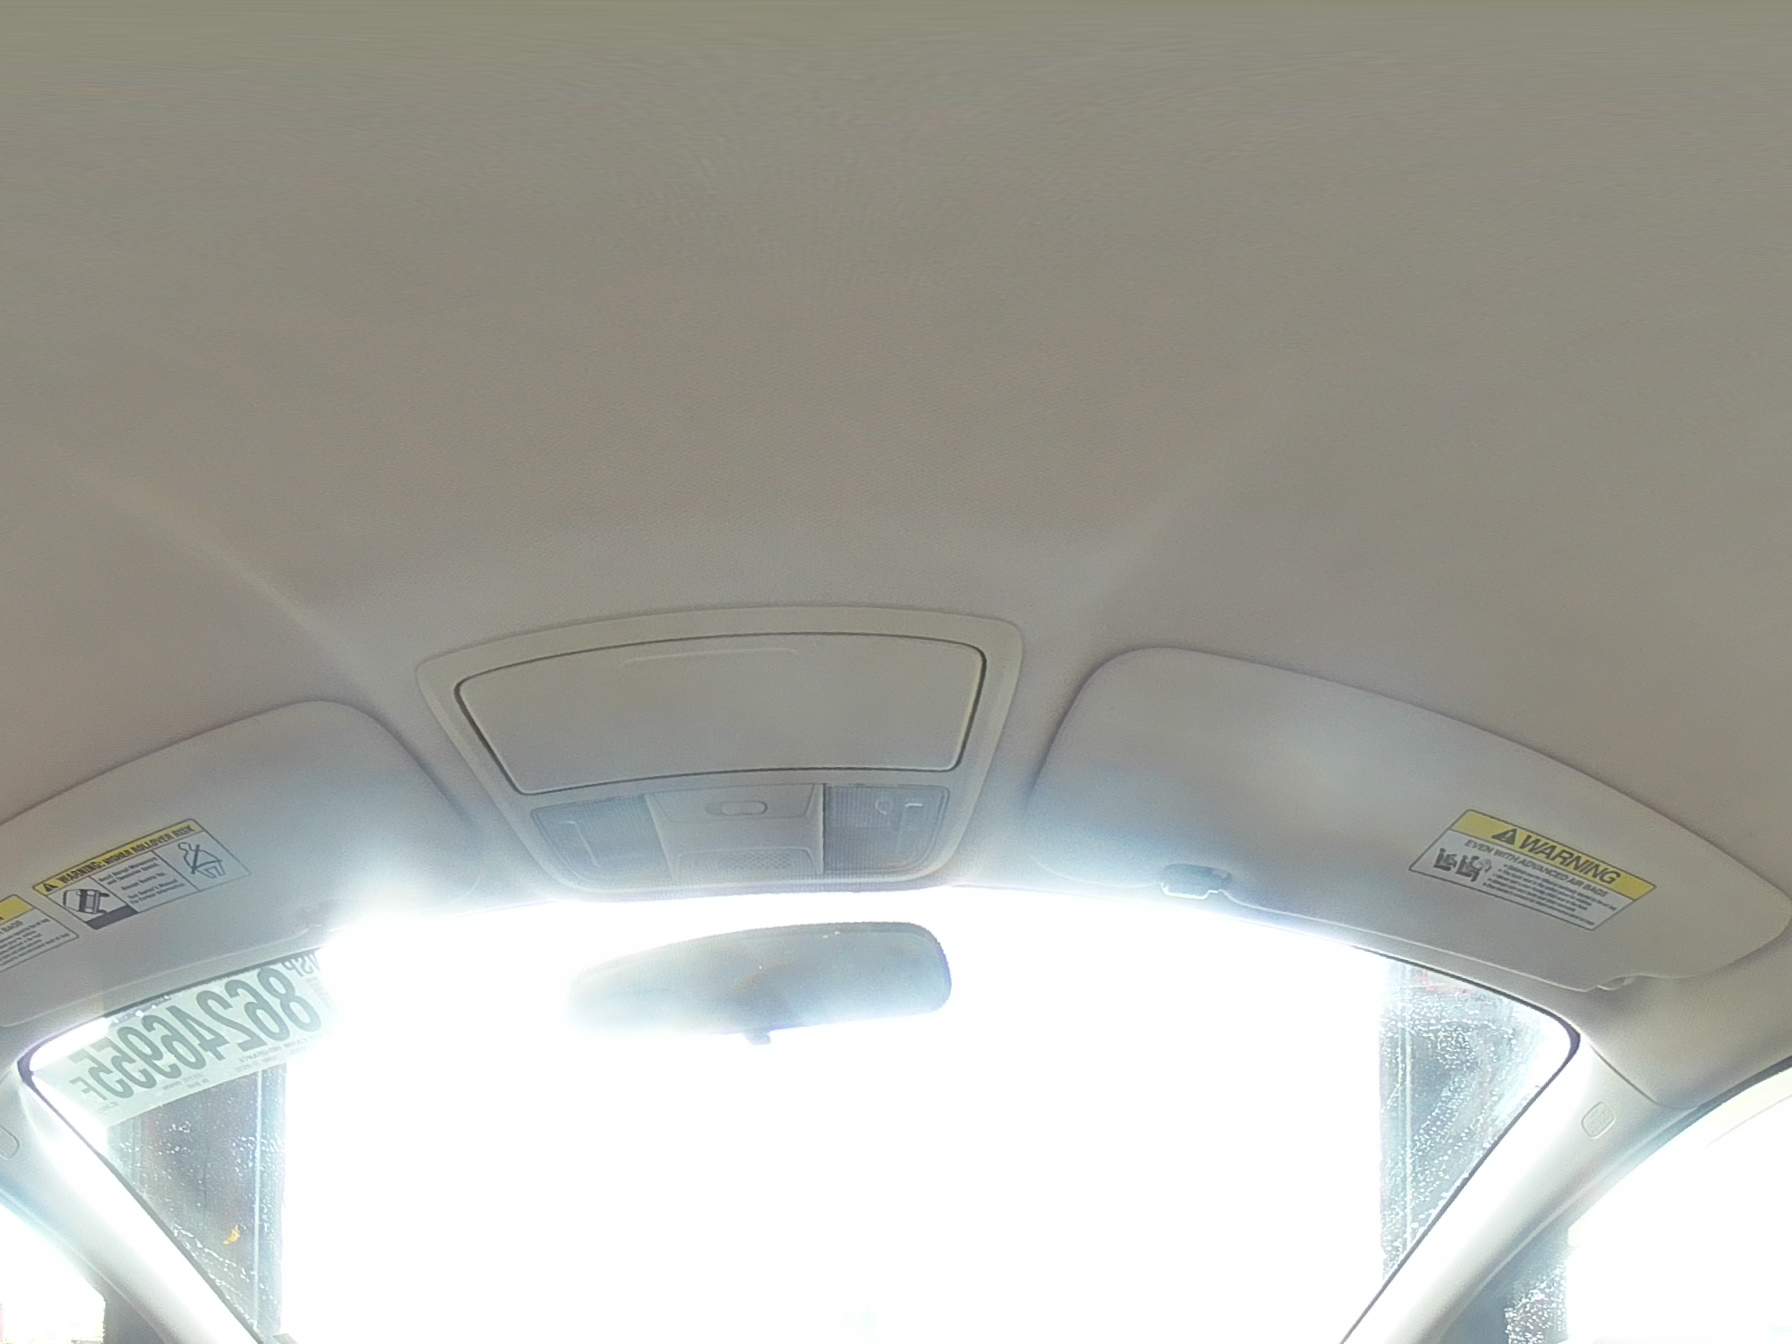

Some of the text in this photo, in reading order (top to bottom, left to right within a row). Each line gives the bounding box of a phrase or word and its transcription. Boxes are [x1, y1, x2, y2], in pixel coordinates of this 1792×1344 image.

[57, 860, 106, 884] WARNING:
[1464, 839, 1492, 854] EVEN
[1492, 845, 1519, 863] WITH
[1516, 852, 1569, 882] ADVANCED
[1518, 834, 1621, 886] WARNING
